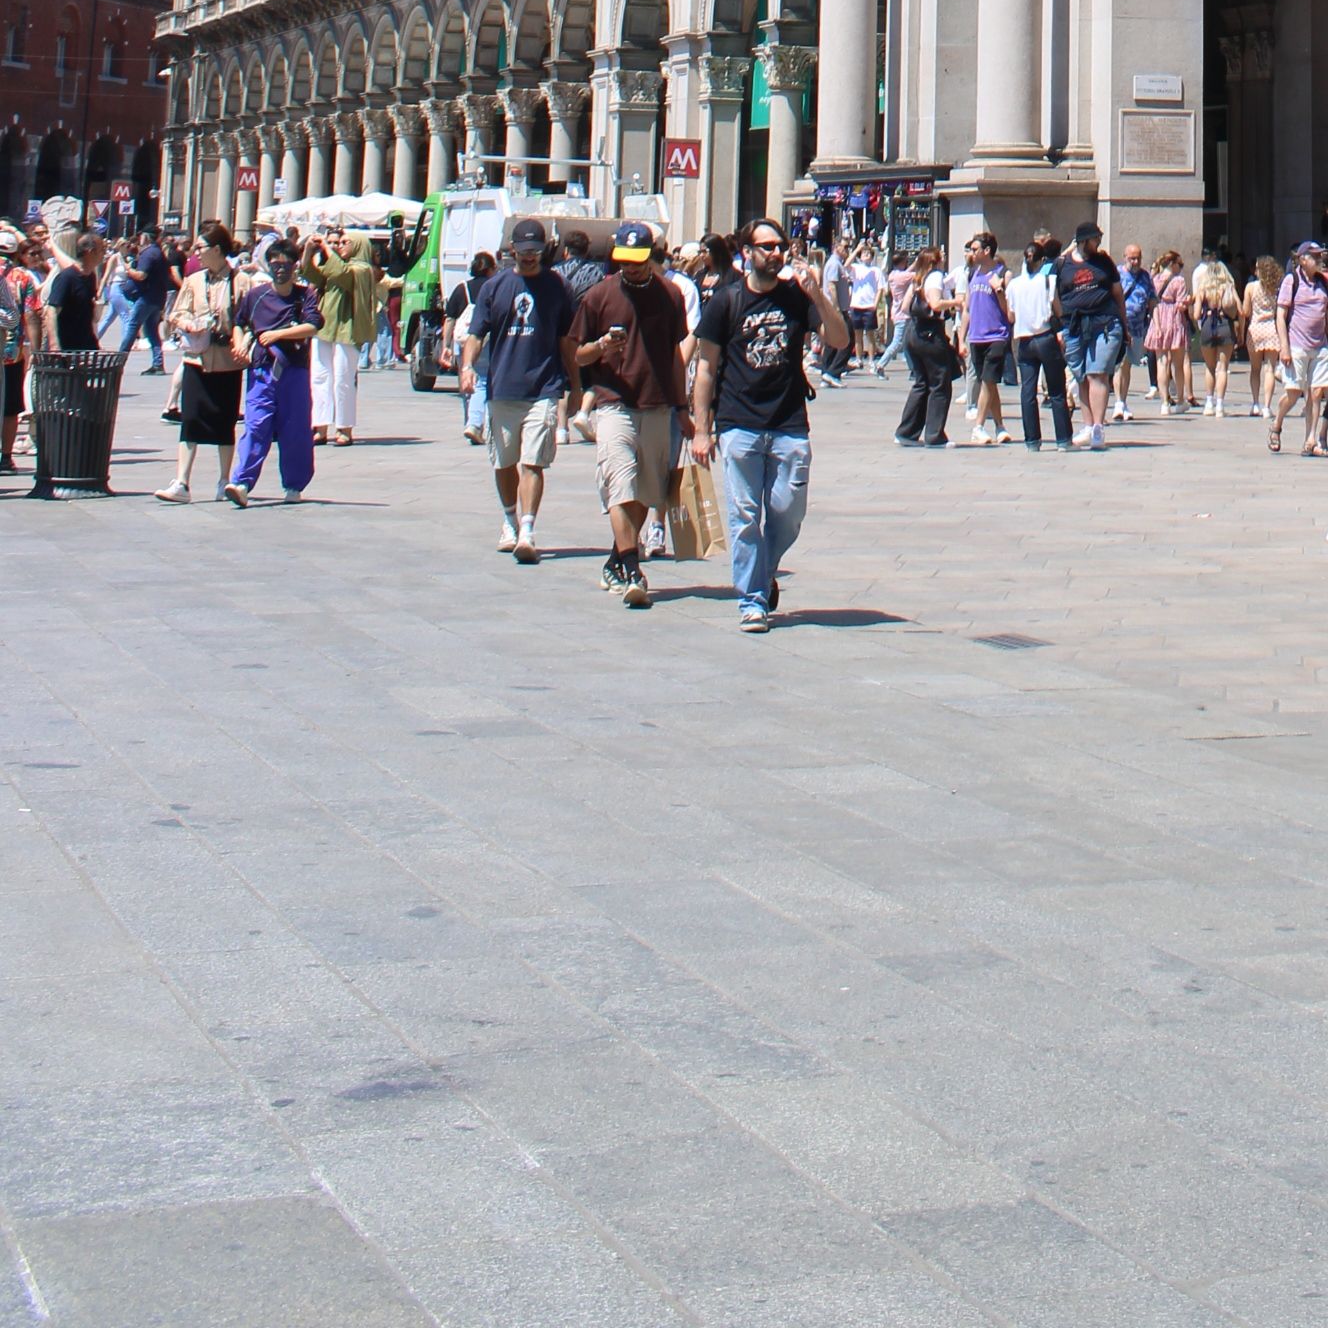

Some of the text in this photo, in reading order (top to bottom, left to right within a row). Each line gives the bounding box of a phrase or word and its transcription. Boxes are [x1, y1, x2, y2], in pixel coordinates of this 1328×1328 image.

[666, 147, 698, 170] M
[239, 172, 258, 187] M
[115, 185, 131, 198] M
[626, 229, 637, 245] S
